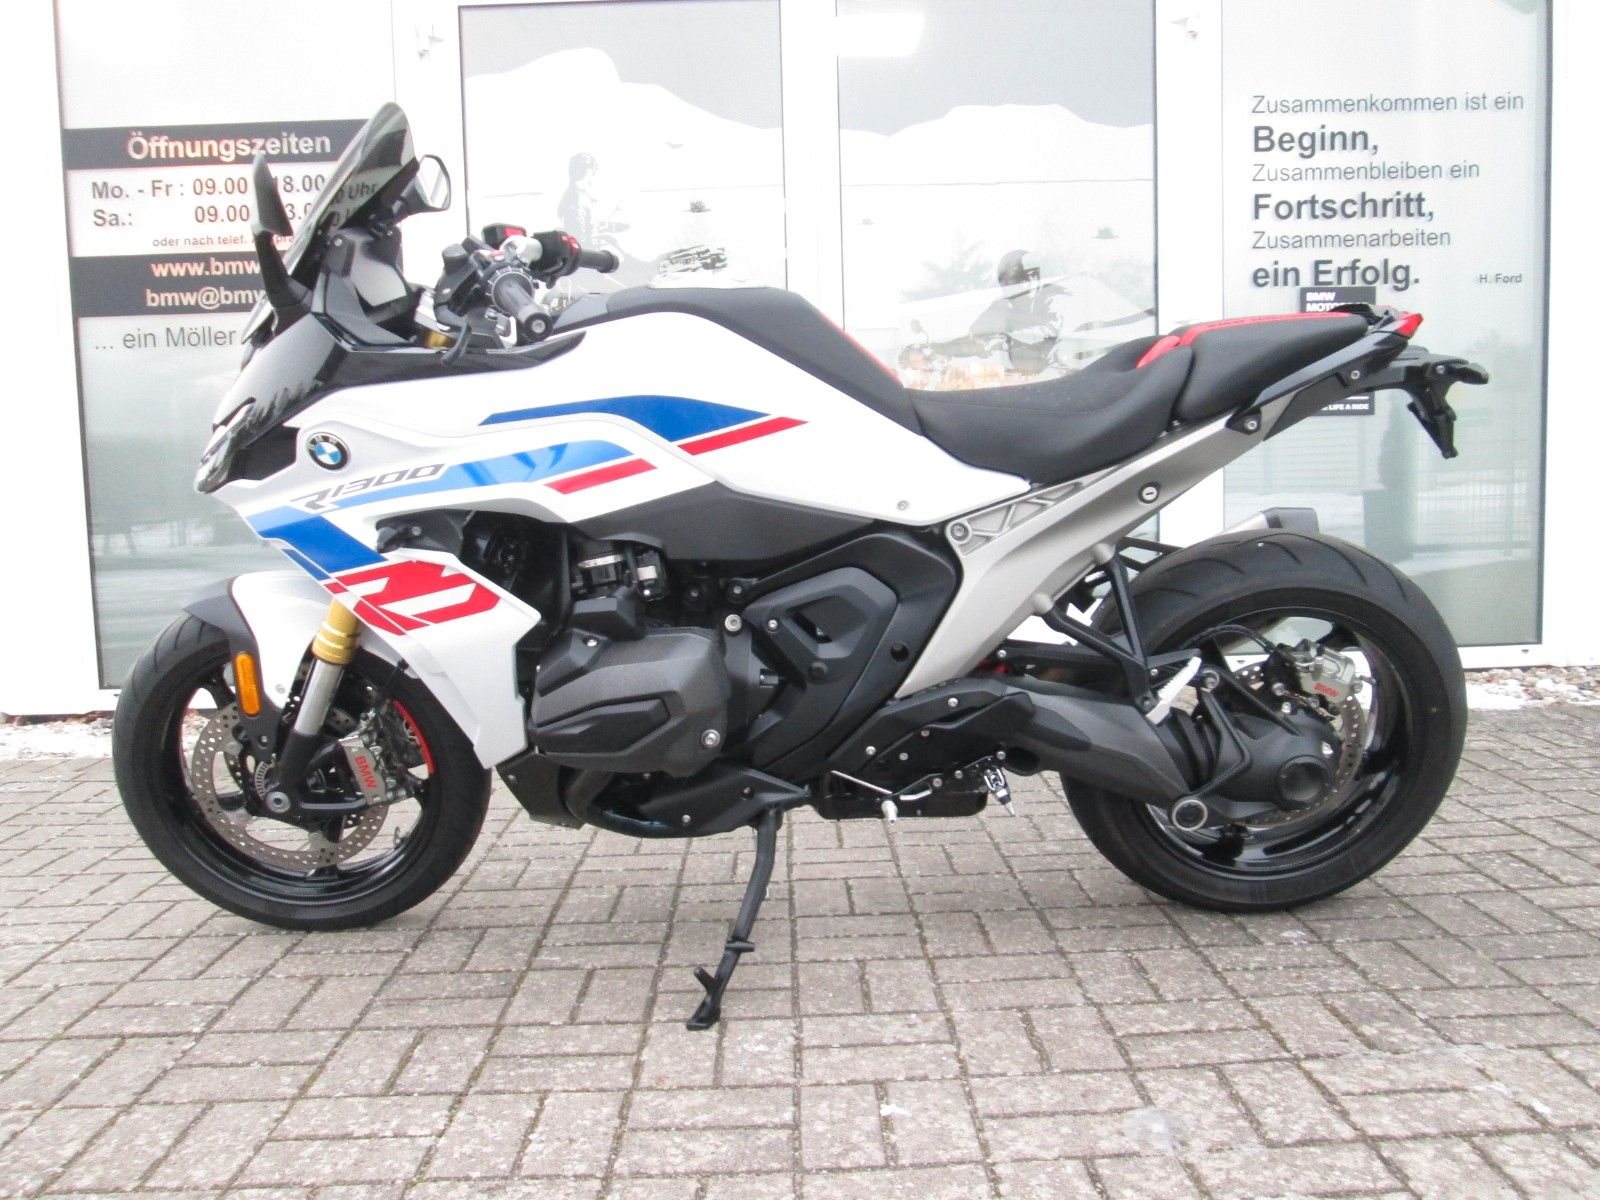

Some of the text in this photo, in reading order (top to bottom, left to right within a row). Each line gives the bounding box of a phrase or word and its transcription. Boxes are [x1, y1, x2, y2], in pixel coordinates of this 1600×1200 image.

[1252, 92, 1524, 114] Zusammenkommen ist ein
[127, 131, 332, 163] Öffnungszeiten
[1254, 125, 1379, 158] Beginn,
[1252, 161, 1480, 182] Zusammenbleiben ein
[91, 181, 130, 199] Mo.
[193, 176, 248, 196] 09.00
[93, 208, 133, 227] Sa.:
[195, 204, 250, 223] 09.00
[1254, 191, 1434, 222] Fortschritt,
[152, 236, 180, 247] oder
[184, 235, 214, 246] nach
[218, 234, 247, 245] telef.
[1252, 229, 1451, 249] Zusammenarbeiten
[151, 257, 261, 278] www.bmw
[1252, 258, 1420, 291] ein Erfolg.
[1479, 273, 1522, 284] H. Ford
[145, 286, 266, 310] bmw@bmw
[1306, 292, 1336, 301] BMW
[123, 329, 156, 349] ein
[165, 326, 236, 348] Möller
[1313, 683, 1341, 698] BMW
[355, 755, 377, 789] BMW
